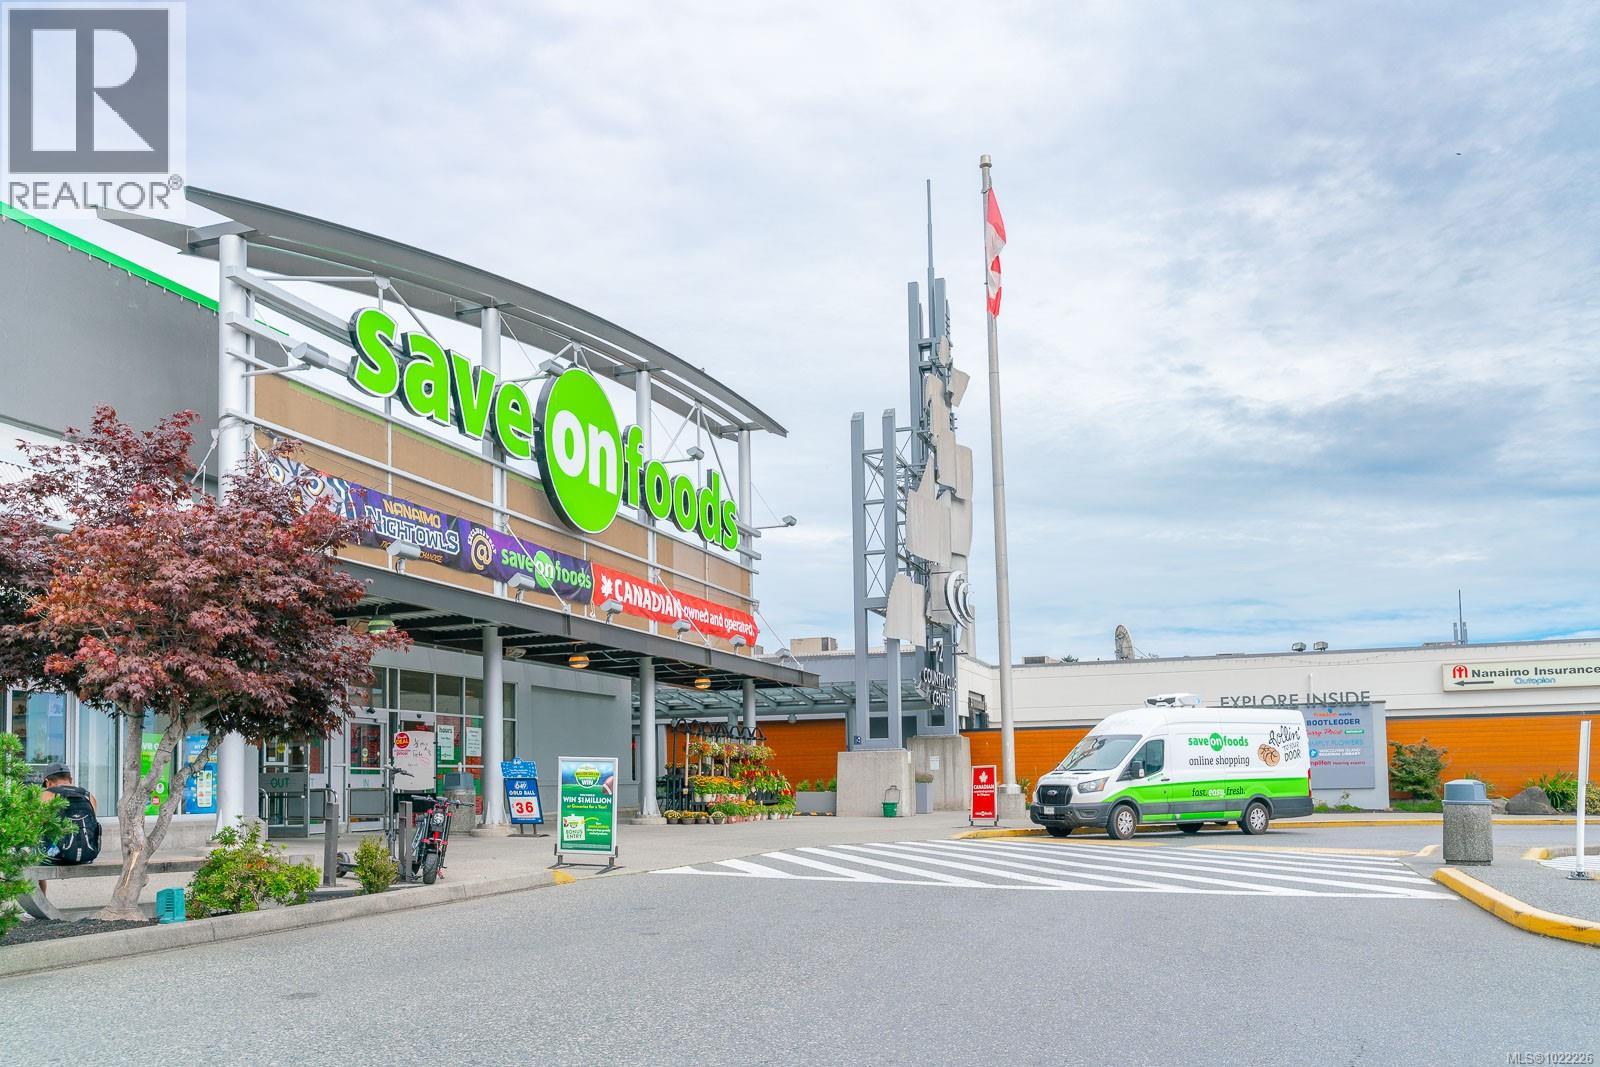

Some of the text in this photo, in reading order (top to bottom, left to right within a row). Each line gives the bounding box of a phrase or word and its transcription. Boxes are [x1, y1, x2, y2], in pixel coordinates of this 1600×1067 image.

[348, 307, 740, 552] save on foods
[383, 499, 441, 528] NANAIMO
[471, 535, 492, 571] @
[501, 548, 592, 589] save on foods
[614, 578, 682, 619] CANADIAN
[684, 606, 709, 623] owned
[710, 613, 723, 627] and
[1471, 666, 1600, 678] Nanaimo Insurance
[1220, 690, 1370, 708] EXPLORE INSIDE
[1306, 718, 1360, 726] BOOTLEGGER
[1188, 735, 1249, 746] save on foods
[1189, 755, 1250, 767] online shopping
[1284, 749, 1301, 762] DOOR
[270, 777, 290, 788] OUT
